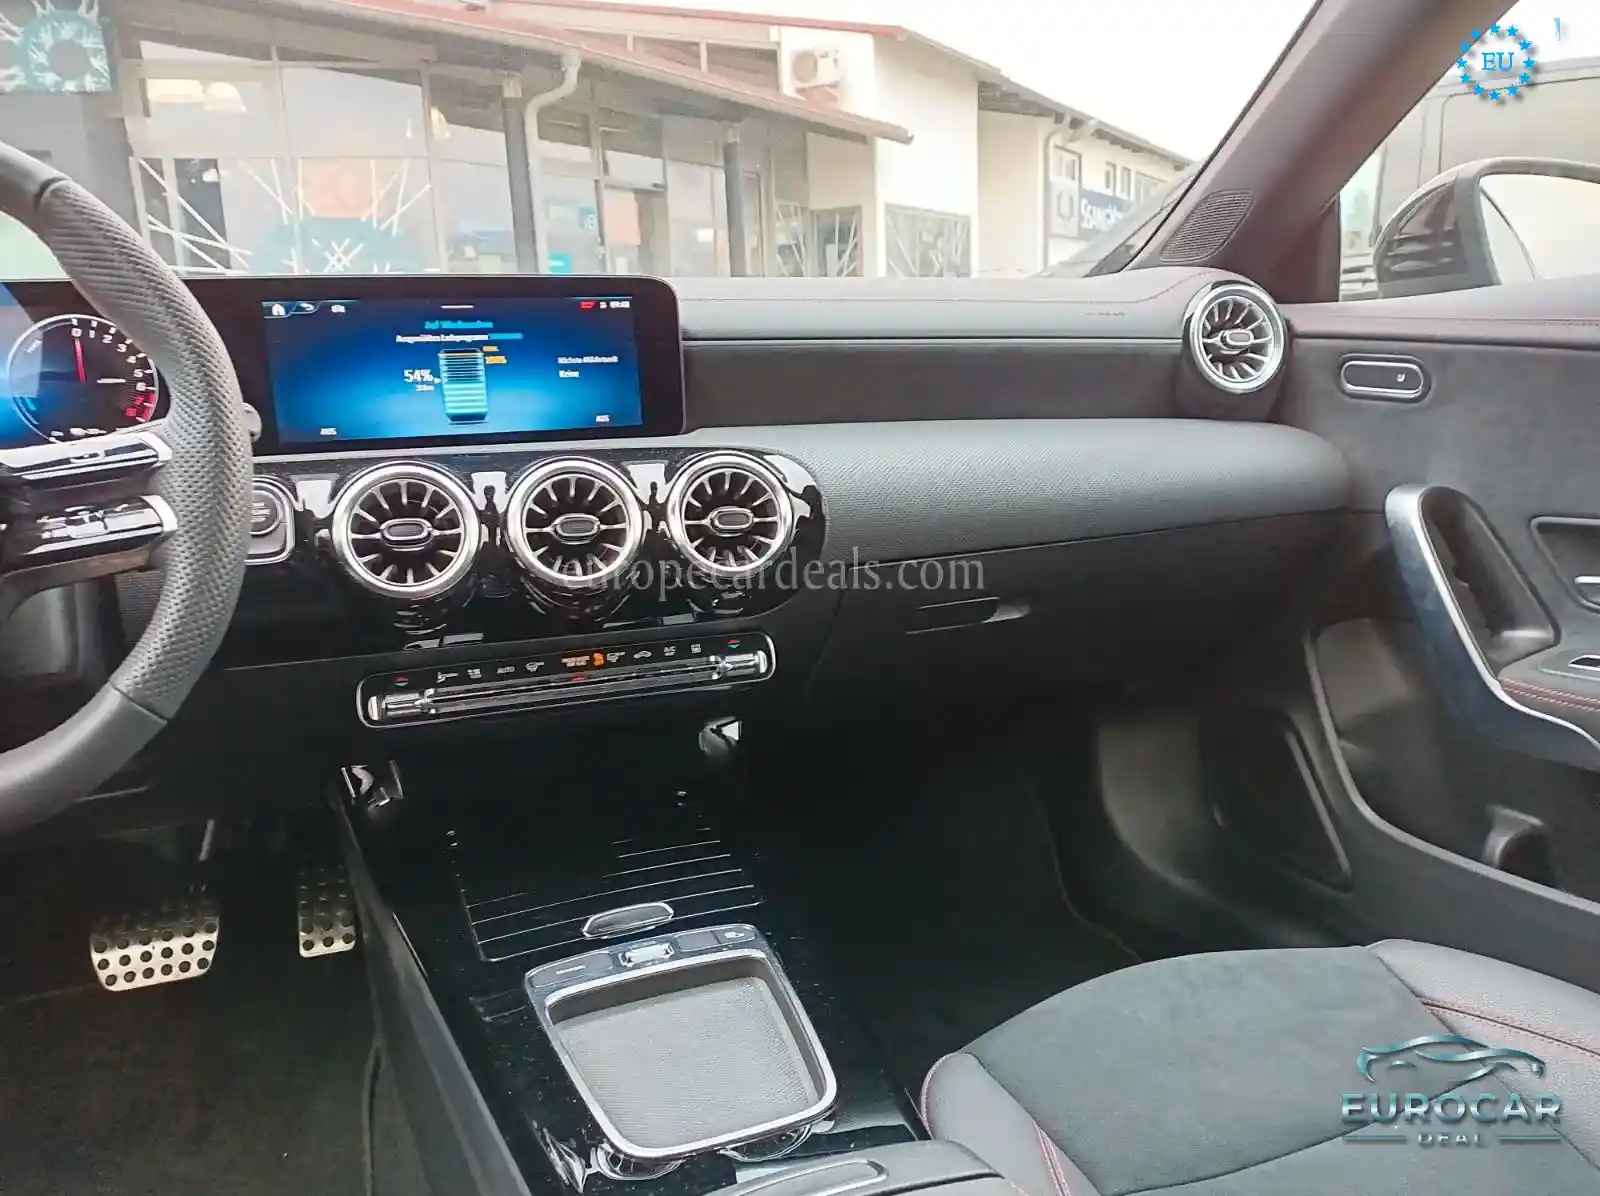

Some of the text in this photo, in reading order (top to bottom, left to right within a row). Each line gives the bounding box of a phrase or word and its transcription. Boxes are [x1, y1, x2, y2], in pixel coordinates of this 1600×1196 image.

[102, 334, 113, 344] 2
[116, 343, 127, 352] 3
[133, 368, 143, 378] 5
[403, 369, 434, 382] 54%
[136, 382, 146, 391] 6
